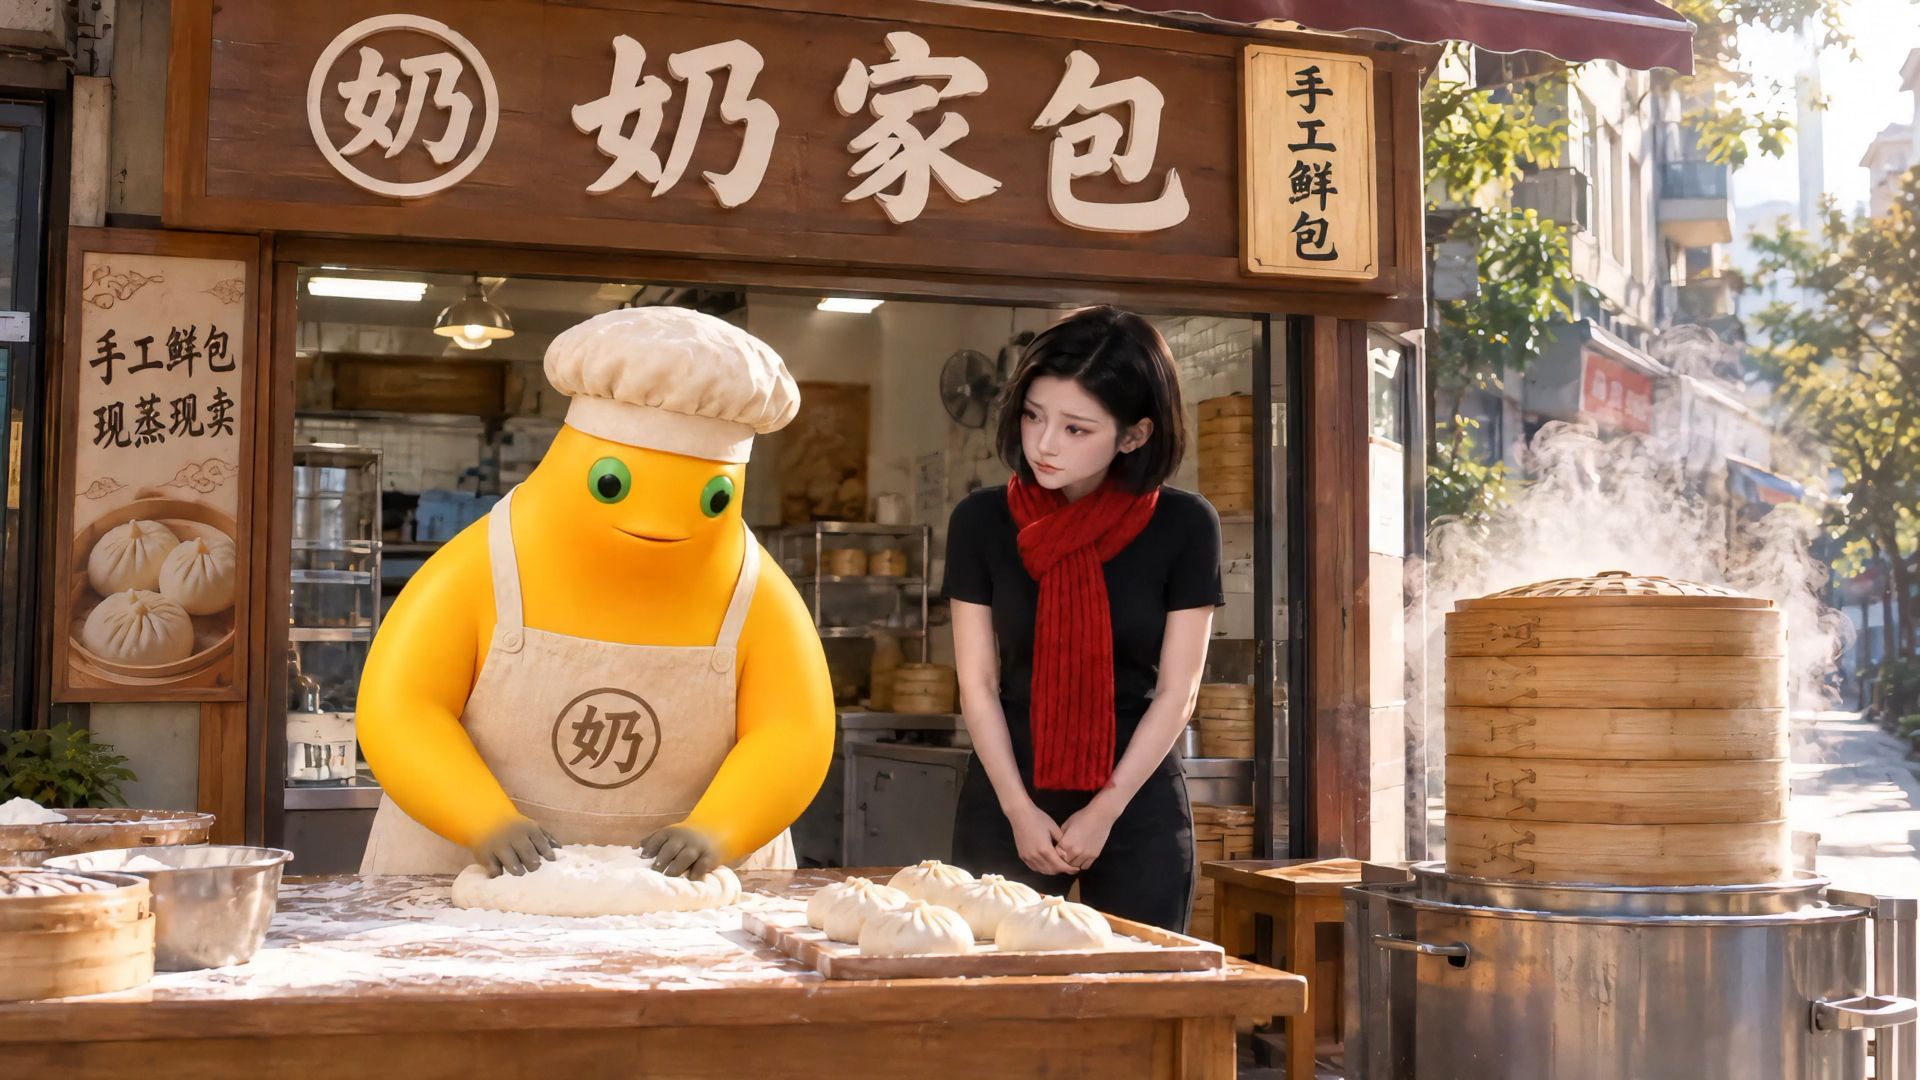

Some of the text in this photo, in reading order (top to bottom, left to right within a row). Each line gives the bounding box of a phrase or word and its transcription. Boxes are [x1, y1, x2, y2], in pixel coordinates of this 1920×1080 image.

[337, 45, 474, 165] 奶
[571, 31, 1190, 232] 奶家包
[1286, 65, 1338, 262] 手工鲜包
[89, 324, 236, 386] 手工鲜包
[93, 386, 235, 449] 现蒸现卖
[569, 704, 643, 774] 奶
